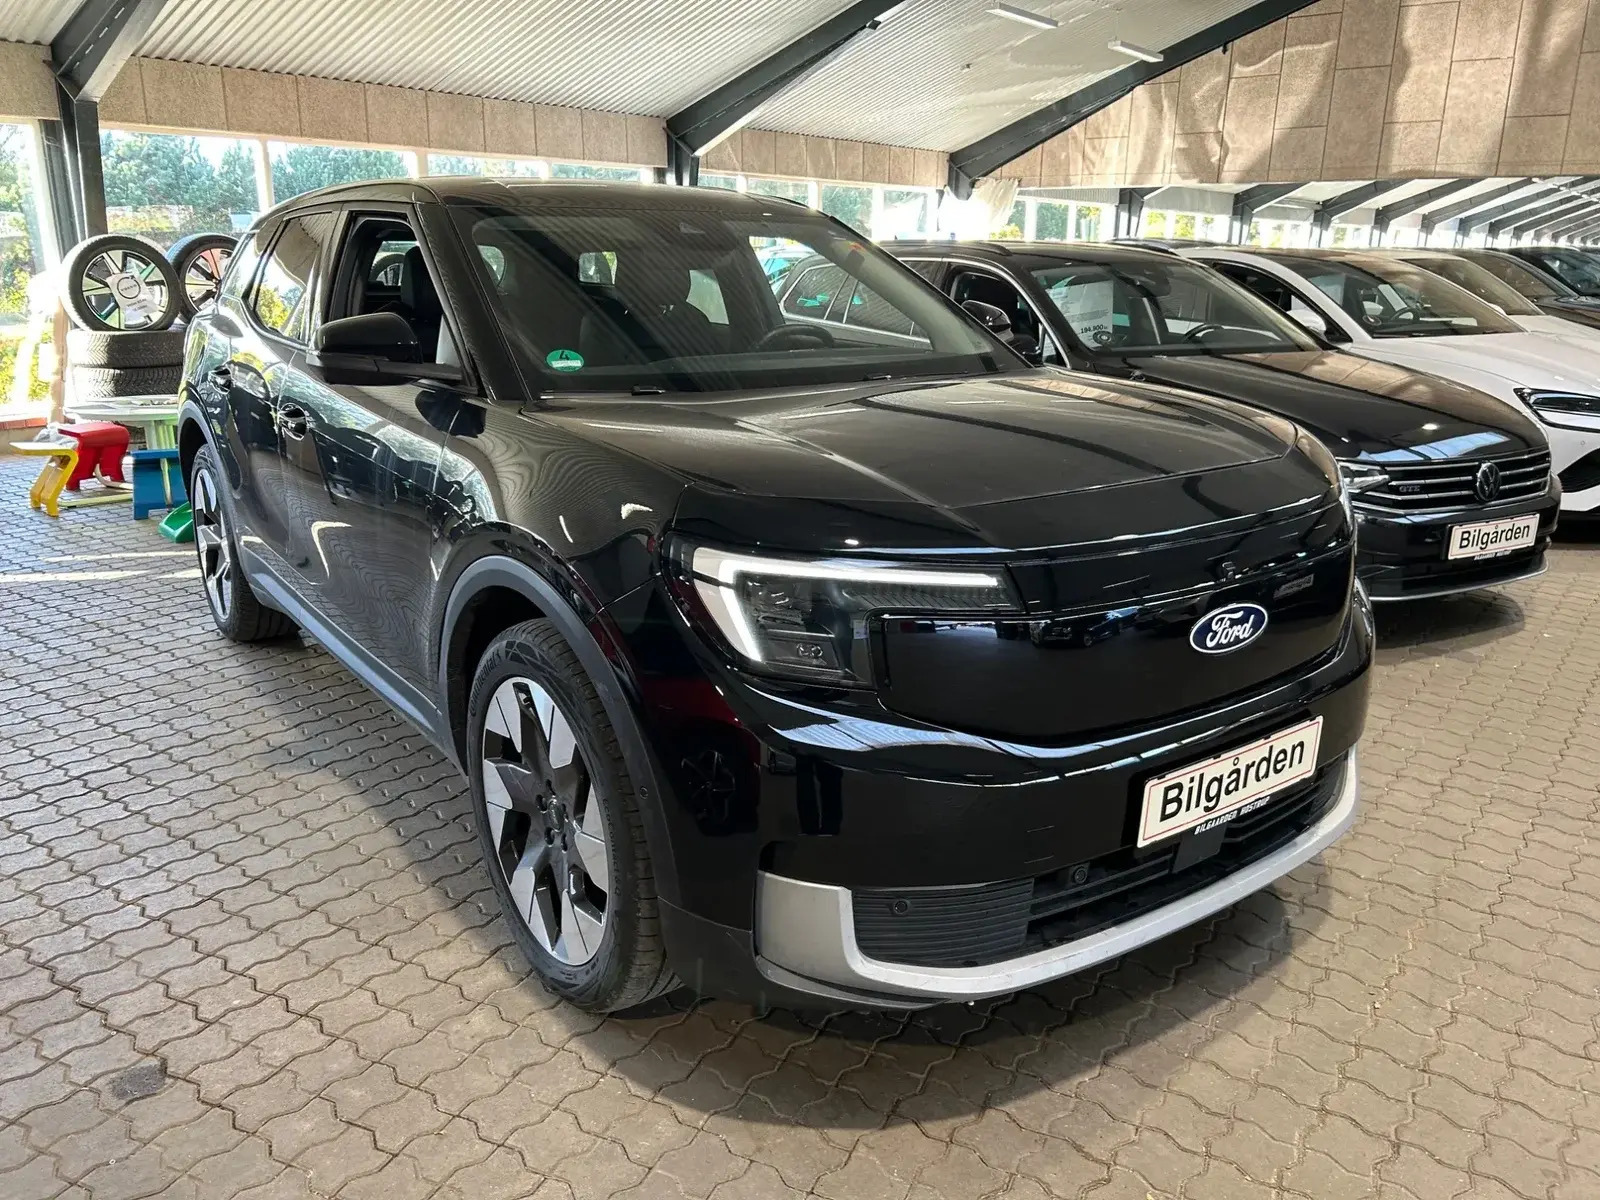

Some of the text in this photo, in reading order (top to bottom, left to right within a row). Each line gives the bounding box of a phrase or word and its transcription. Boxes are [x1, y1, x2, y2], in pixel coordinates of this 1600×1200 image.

[1459, 523, 1530, 550] Bilgården
[1206, 610, 1255, 648] Ford
[1159, 740, 1305, 822] Bilgården
